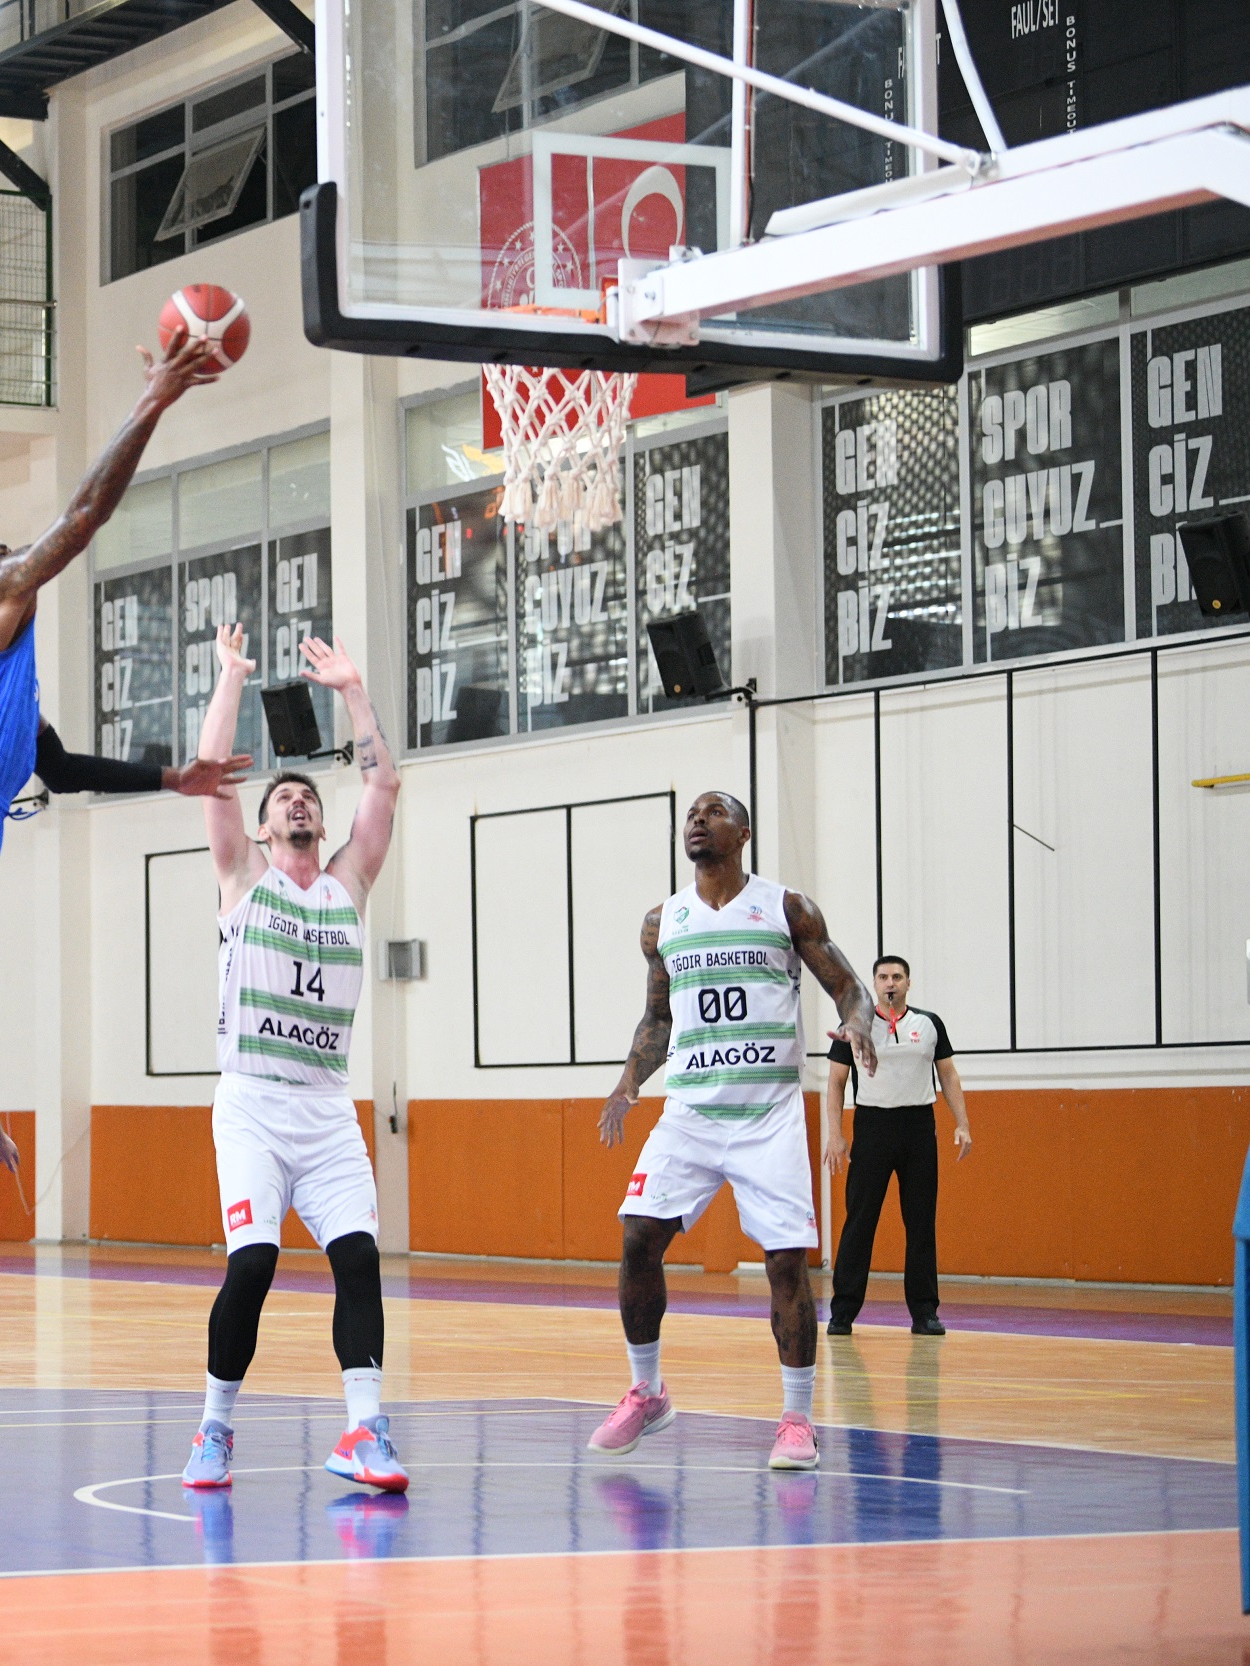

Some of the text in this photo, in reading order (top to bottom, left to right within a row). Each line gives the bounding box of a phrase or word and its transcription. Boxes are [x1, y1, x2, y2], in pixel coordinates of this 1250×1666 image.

[1066, 15, 1076, 73] BONUS
[884, 79, 894, 183] BONU TIMEO
[1147, 343, 1224, 429] GEN
[981, 379, 1073, 466] SPOR
[835, 419, 898, 496] GEN
[646, 464, 702, 537] GEN
[982, 459, 1097, 549] CUYUZ
[276, 552, 318, 615] GEN
[415, 520, 463, 586] GEN
[1150, 521, 1199, 607] Bİ
[100, 594, 138, 652] GEN
[184, 571, 238, 633] SPOR
[984, 553, 1043, 634] BİZ
[290, 960, 325, 1002] 14
[706, 950, 768, 968] BASKETBOL
[258, 1017, 339, 1051] ALAGÖZ
[698, 986, 748, 1024] 00
[686, 1042, 776, 1071] ALAGÖZ
[229, 1208, 247, 1226] RM
